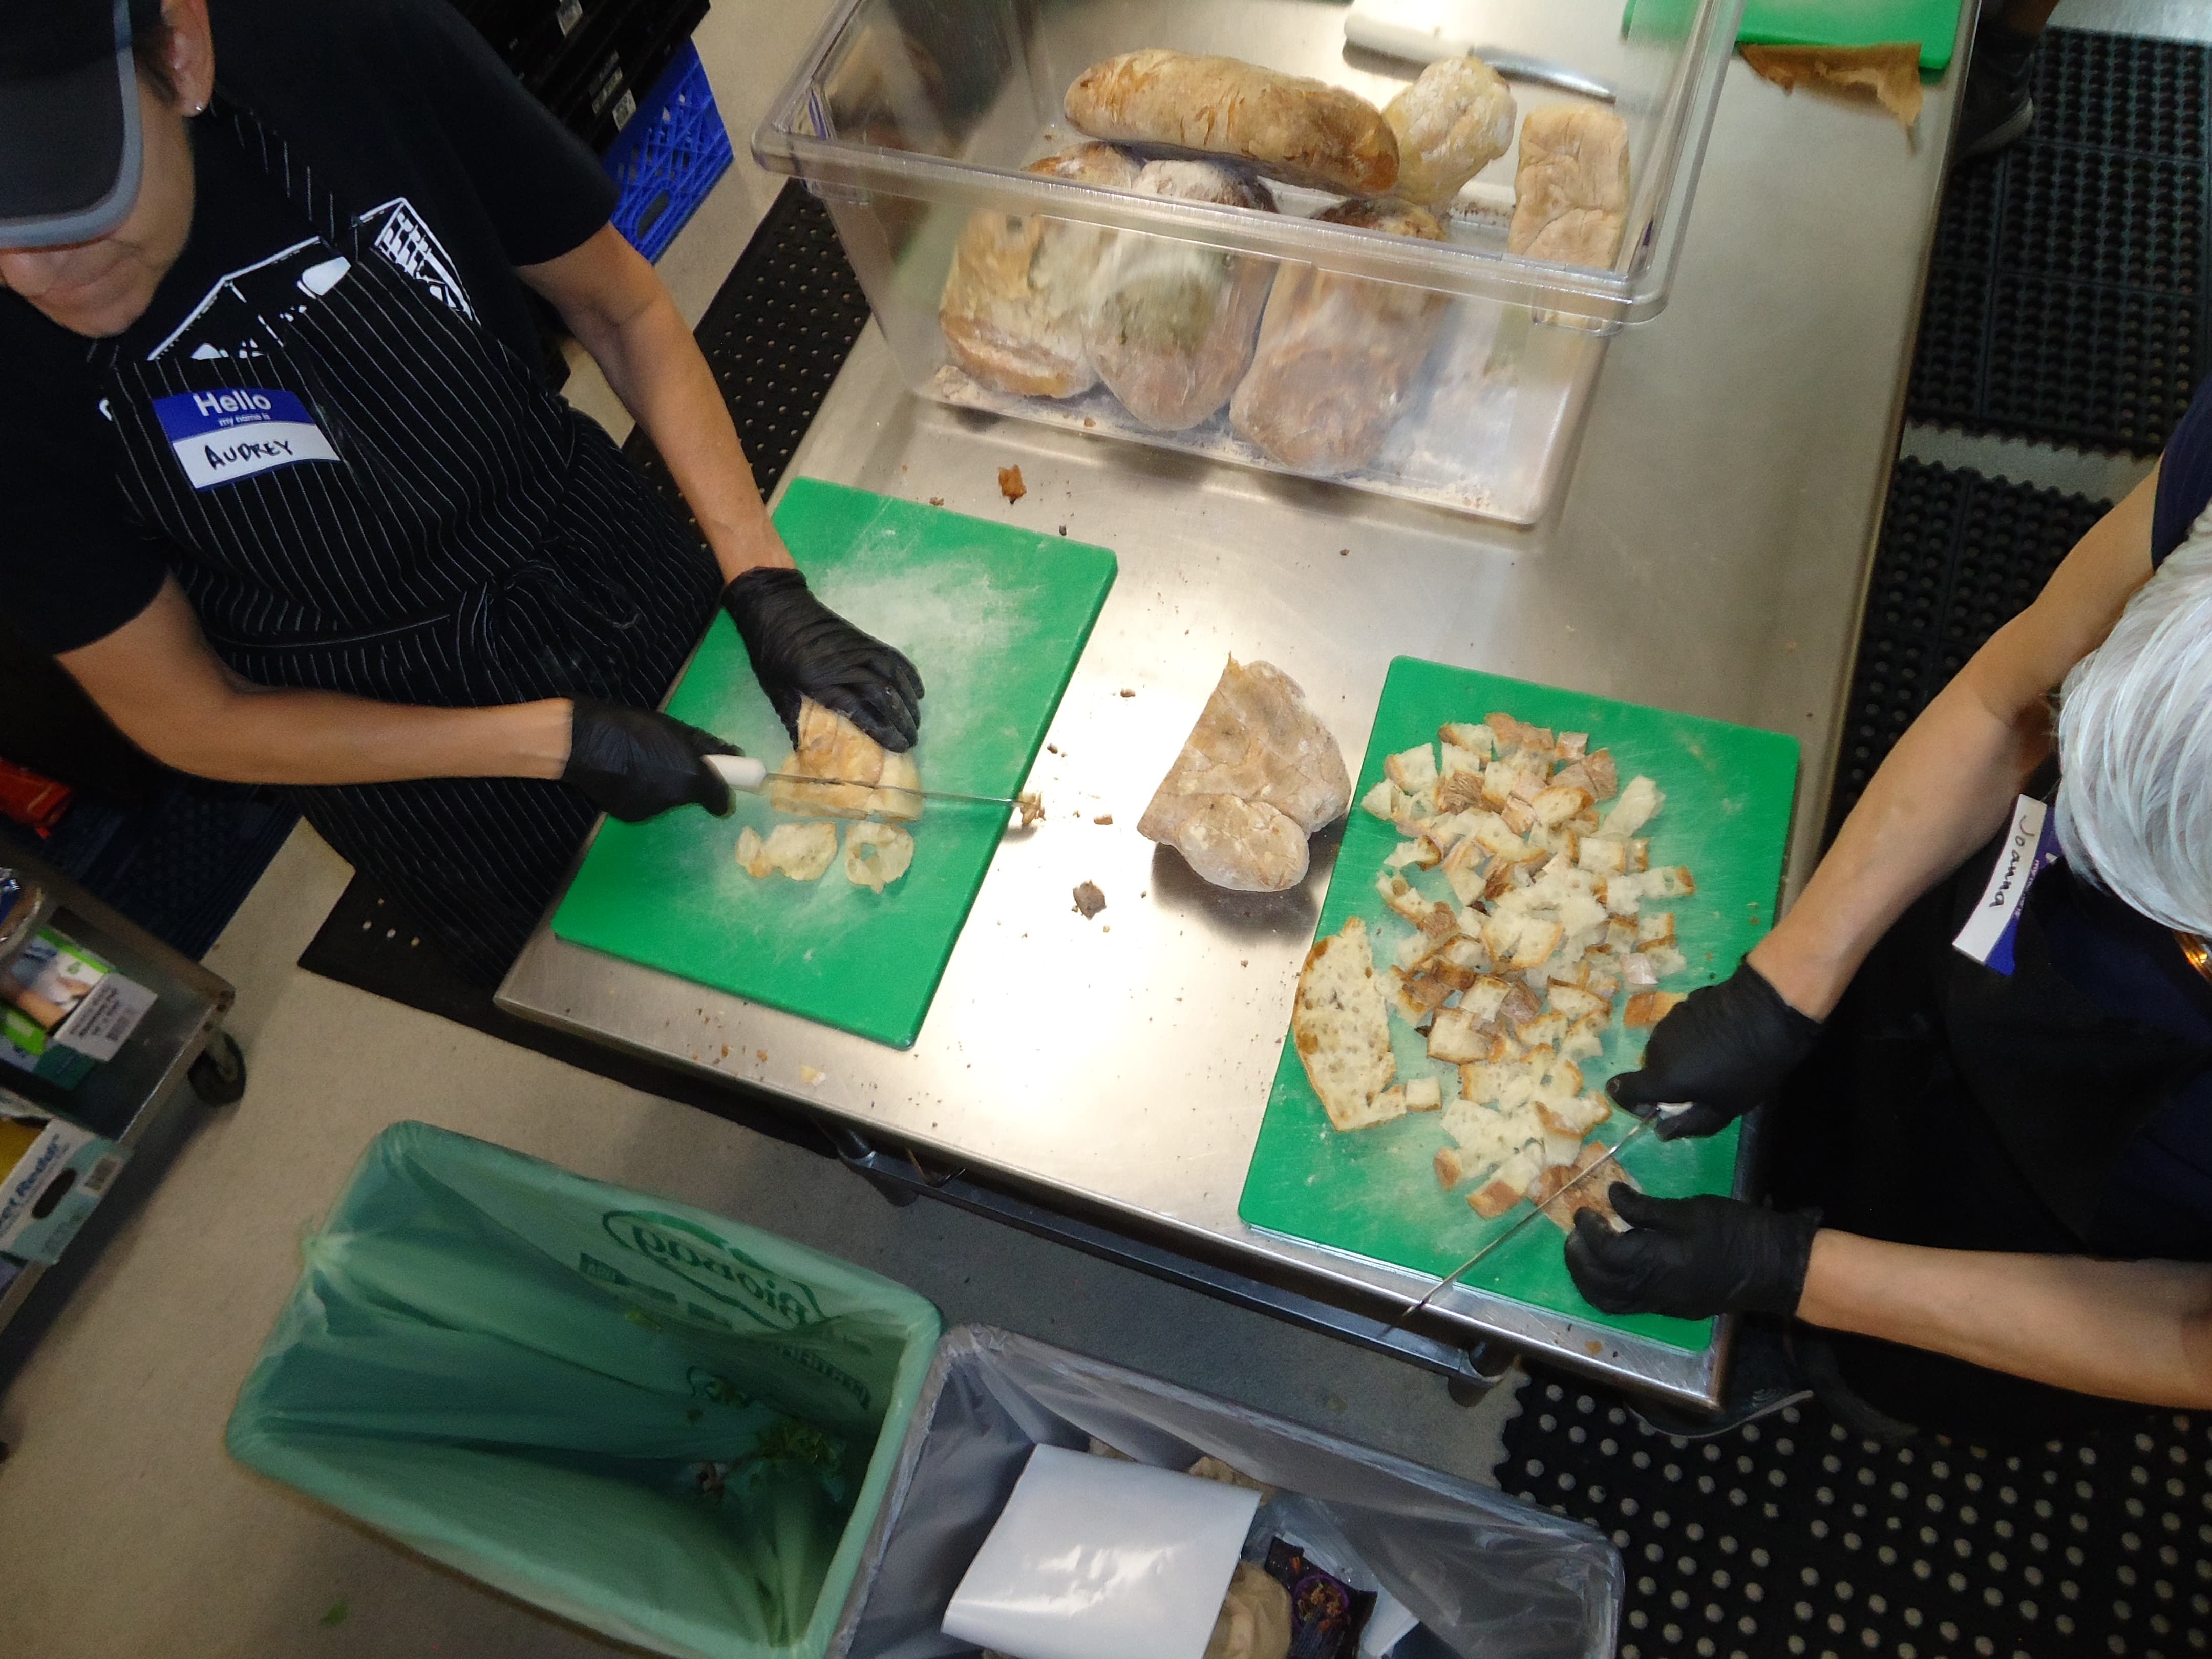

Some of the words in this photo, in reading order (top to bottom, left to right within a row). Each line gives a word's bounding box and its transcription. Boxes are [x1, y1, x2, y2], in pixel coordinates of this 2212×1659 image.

[193, 390, 272, 416] Hello
[219, 417, 233, 427] my
[235, 413, 263, 423] name
[205, 441, 293, 470] AUDREY
[1989, 815, 2035, 907] Joanna
